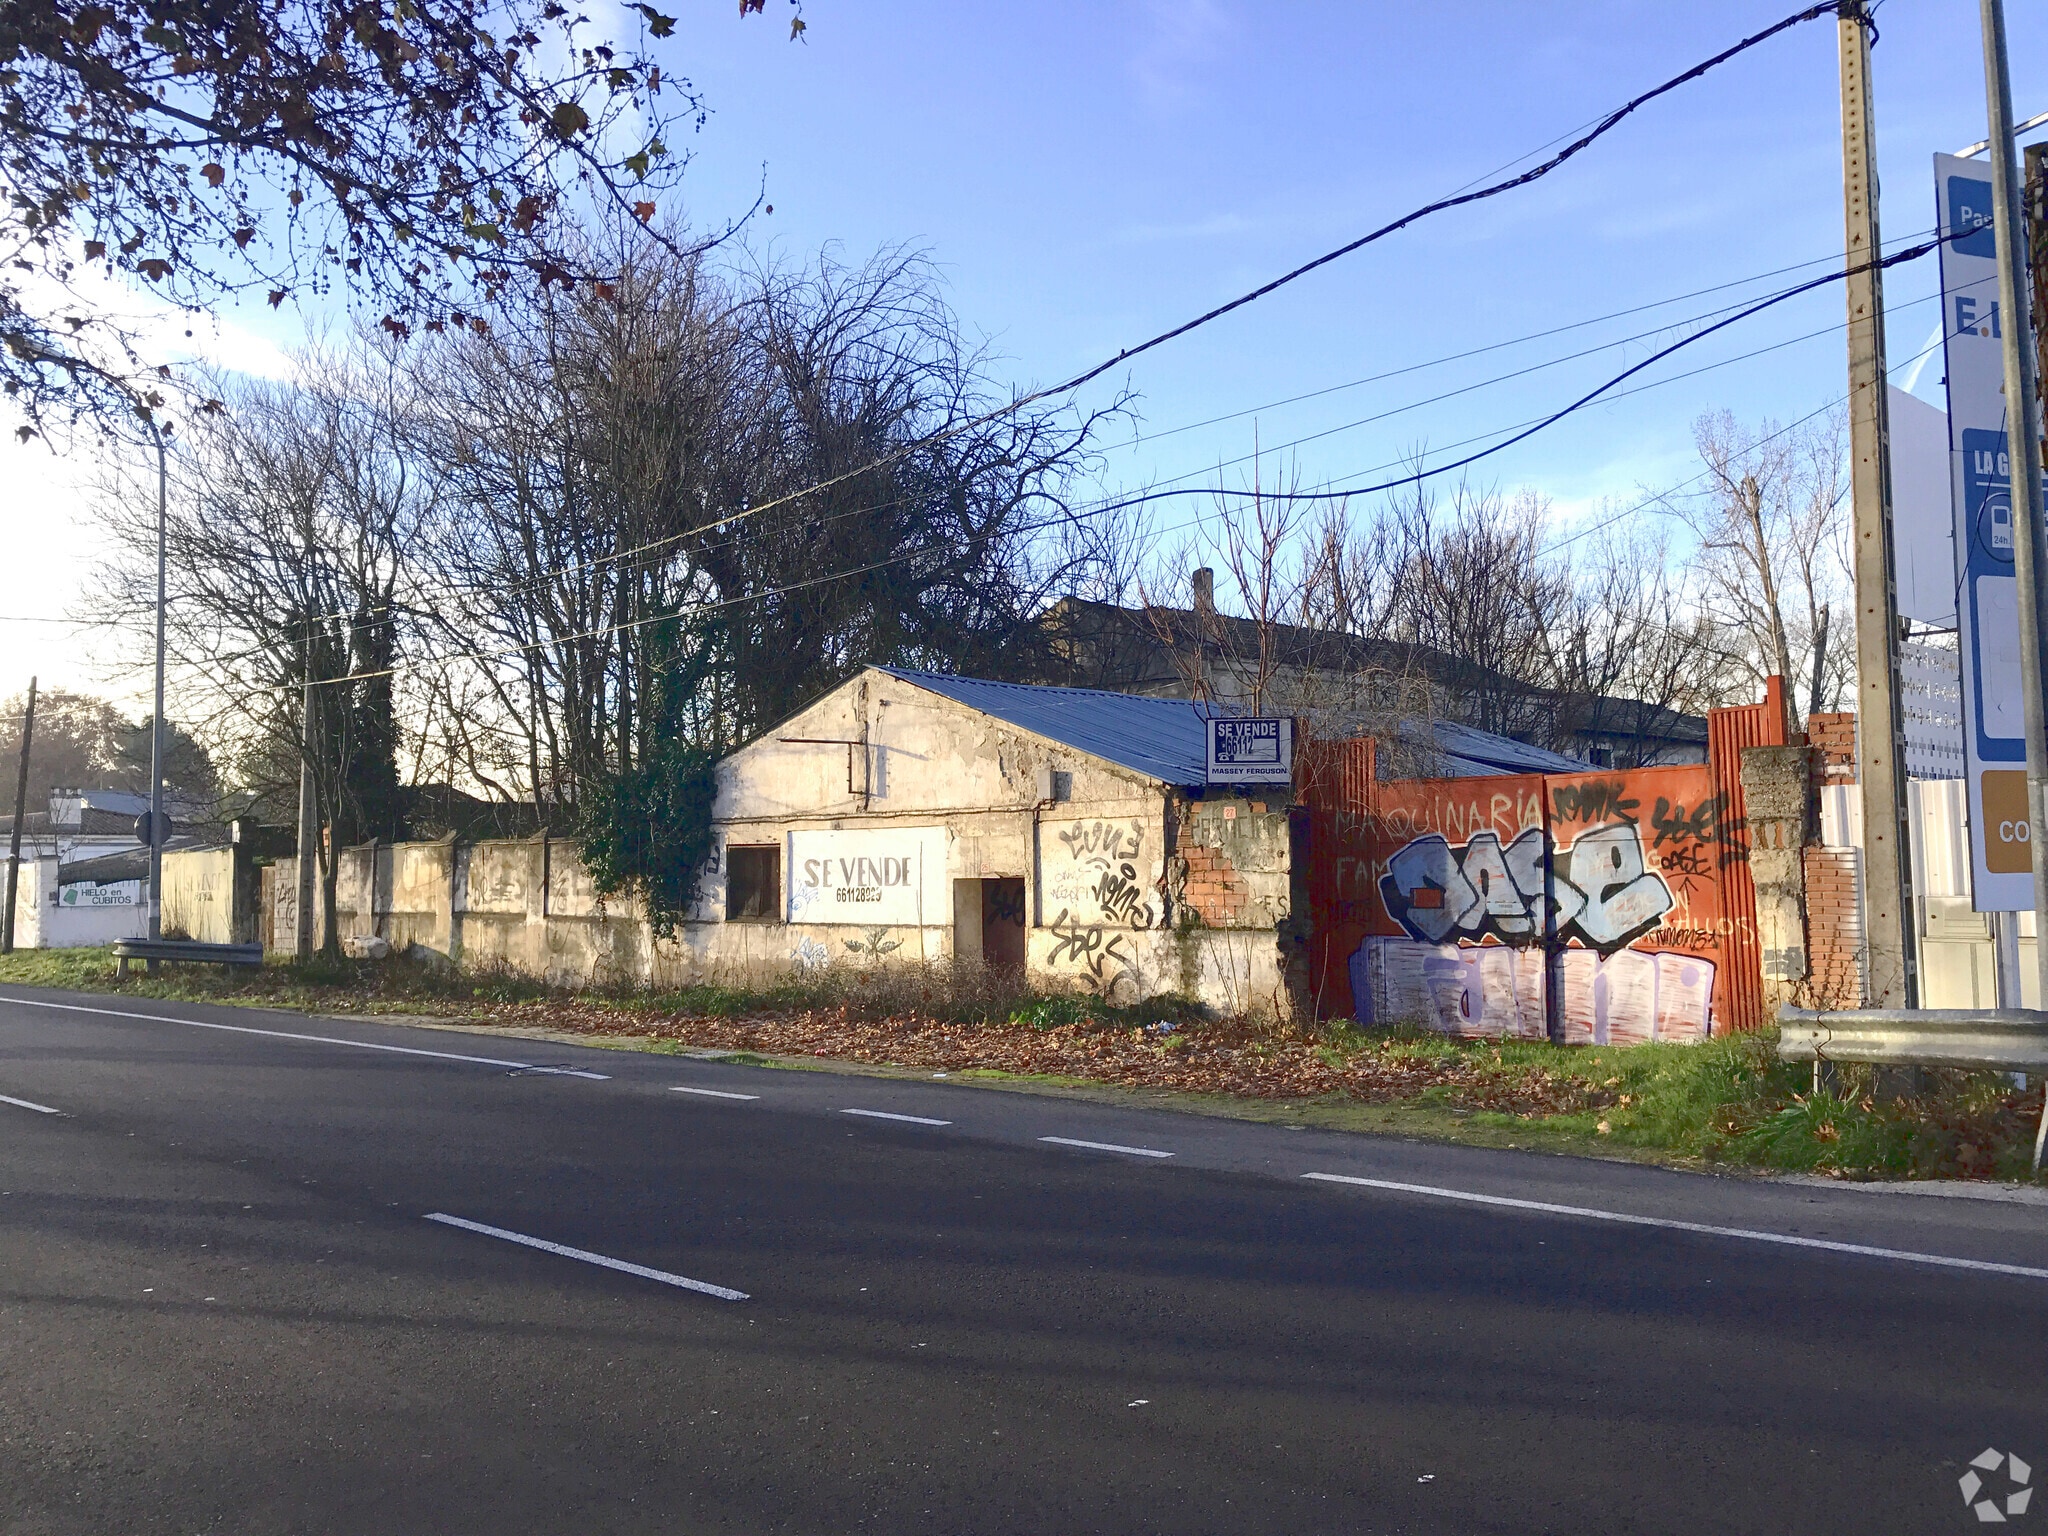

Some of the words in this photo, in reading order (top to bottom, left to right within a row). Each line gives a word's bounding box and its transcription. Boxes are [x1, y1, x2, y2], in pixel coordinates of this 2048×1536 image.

[1974, 450, 1994, 475] LA
[1218, 723, 1232, 736] SE
[1236, 723, 1276, 736] VENDE
[1999, 820, 2031, 843] CO
[804, 858, 833, 887] SE
[839, 857, 912, 886] VENDE
[81, 888, 107, 897] HIELO
[92, 896, 132, 905] CUBITOS
